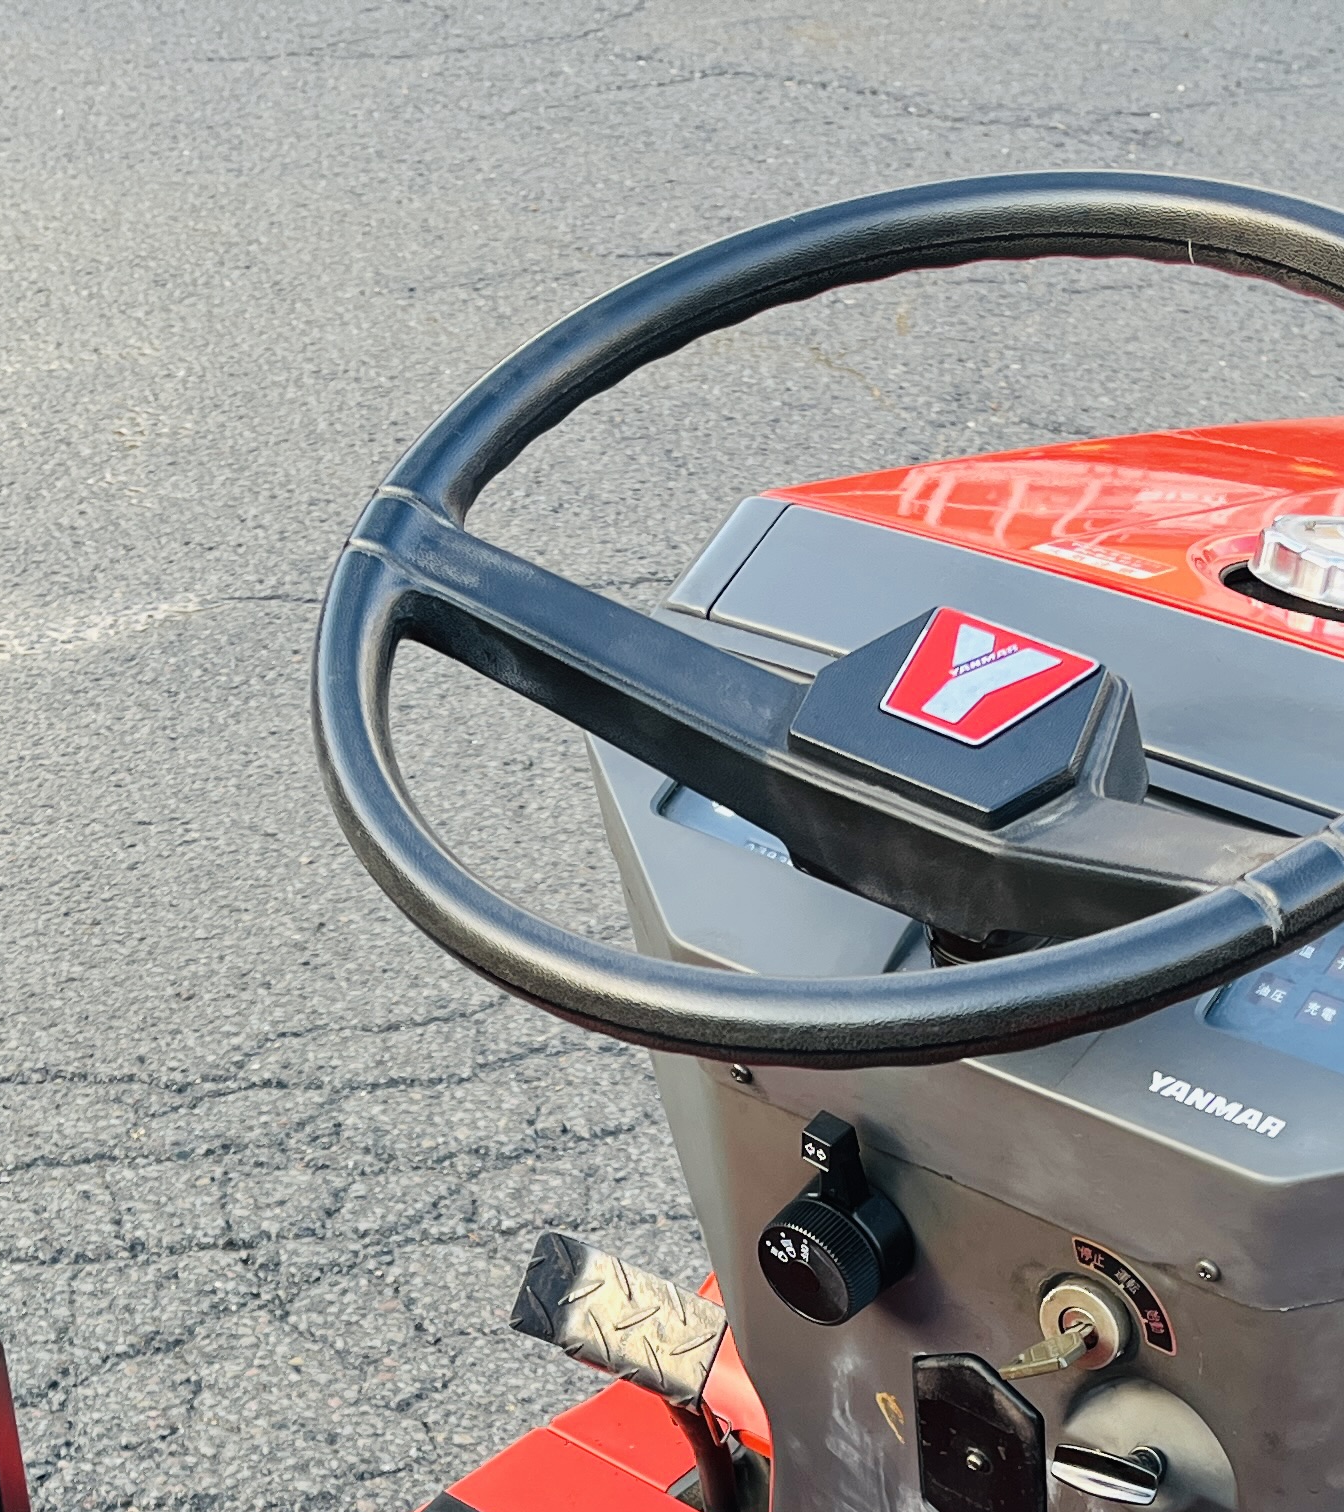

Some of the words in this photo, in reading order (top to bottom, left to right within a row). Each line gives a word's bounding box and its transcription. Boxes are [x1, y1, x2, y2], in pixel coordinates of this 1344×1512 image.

[949, 643, 1020, 678] YANMAR
[1255, 981, 1288, 1004] 油圧
[1306, 1000, 1337, 1023] 充電
[1148, 1070, 1288, 1140] YANMAR
[1077, 1245, 1105, 1269] 停止
[1113, 1267, 1141, 1295] 運転
